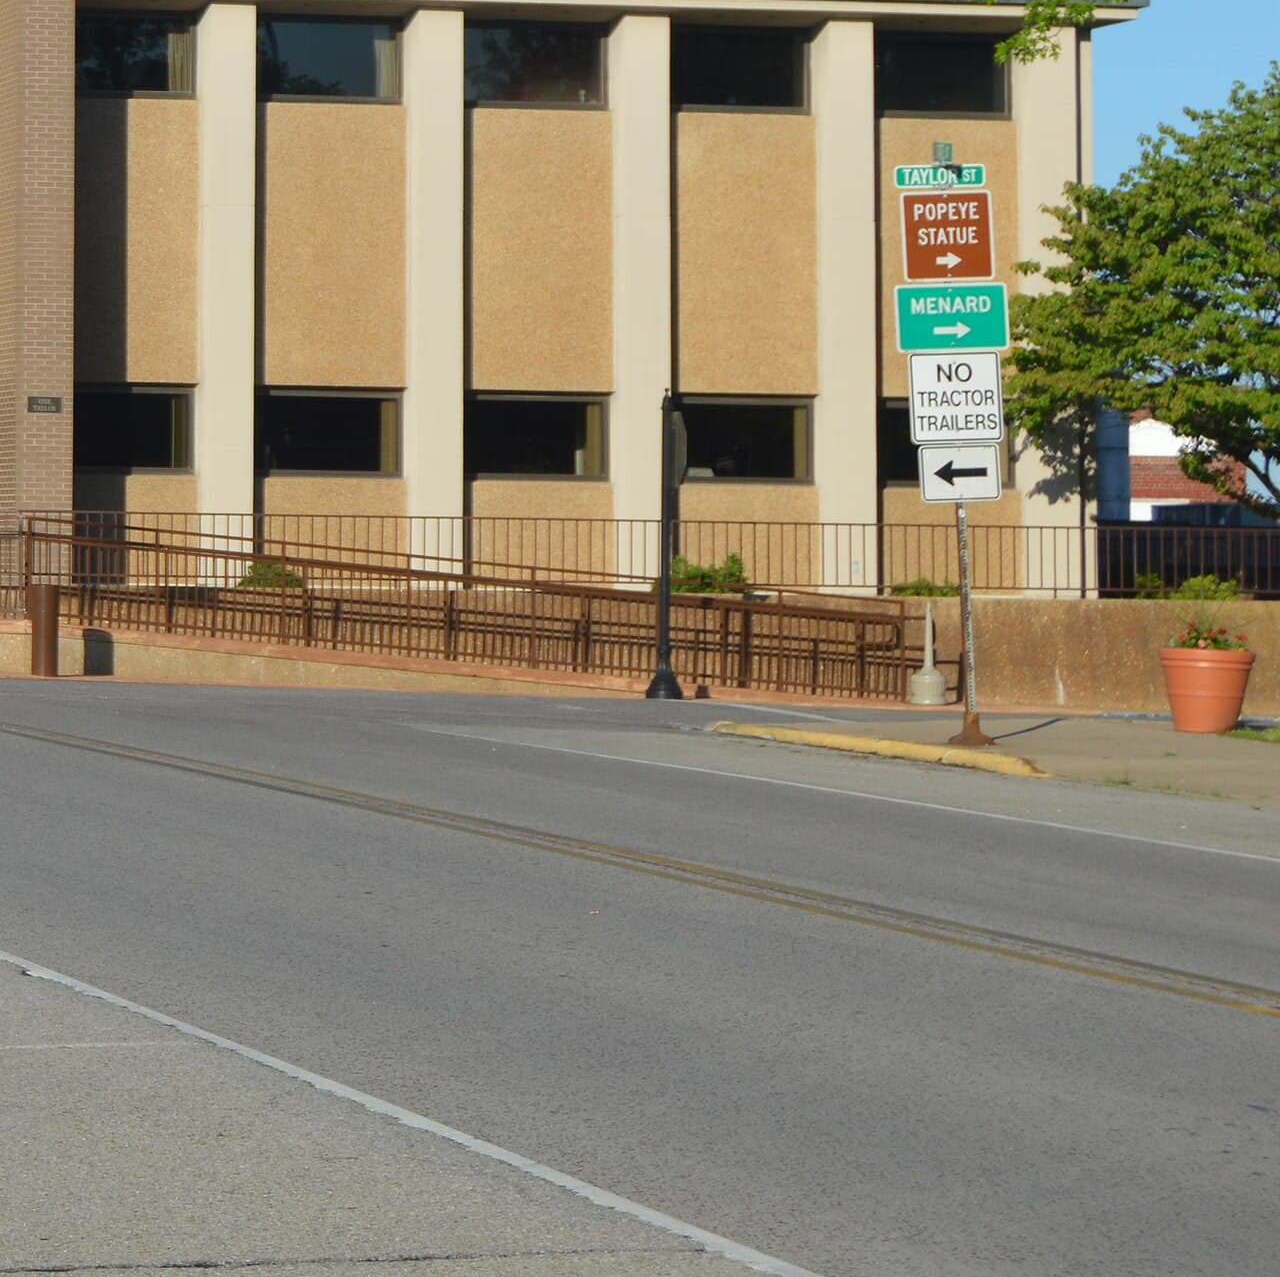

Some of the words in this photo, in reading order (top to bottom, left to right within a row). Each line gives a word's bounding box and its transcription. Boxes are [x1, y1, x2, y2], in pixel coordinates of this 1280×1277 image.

[902, 167, 959, 184] TAYLOR
[961, 169, 977, 182] ST
[913, 201, 980, 221] POPEYE
[917, 226, 979, 245] STATUE
[910, 295, 992, 315] MENARD
[936, 363, 972, 383] NO
[917, 389, 995, 407] TRACTOR
[917, 413, 998, 431] TRAILERS
